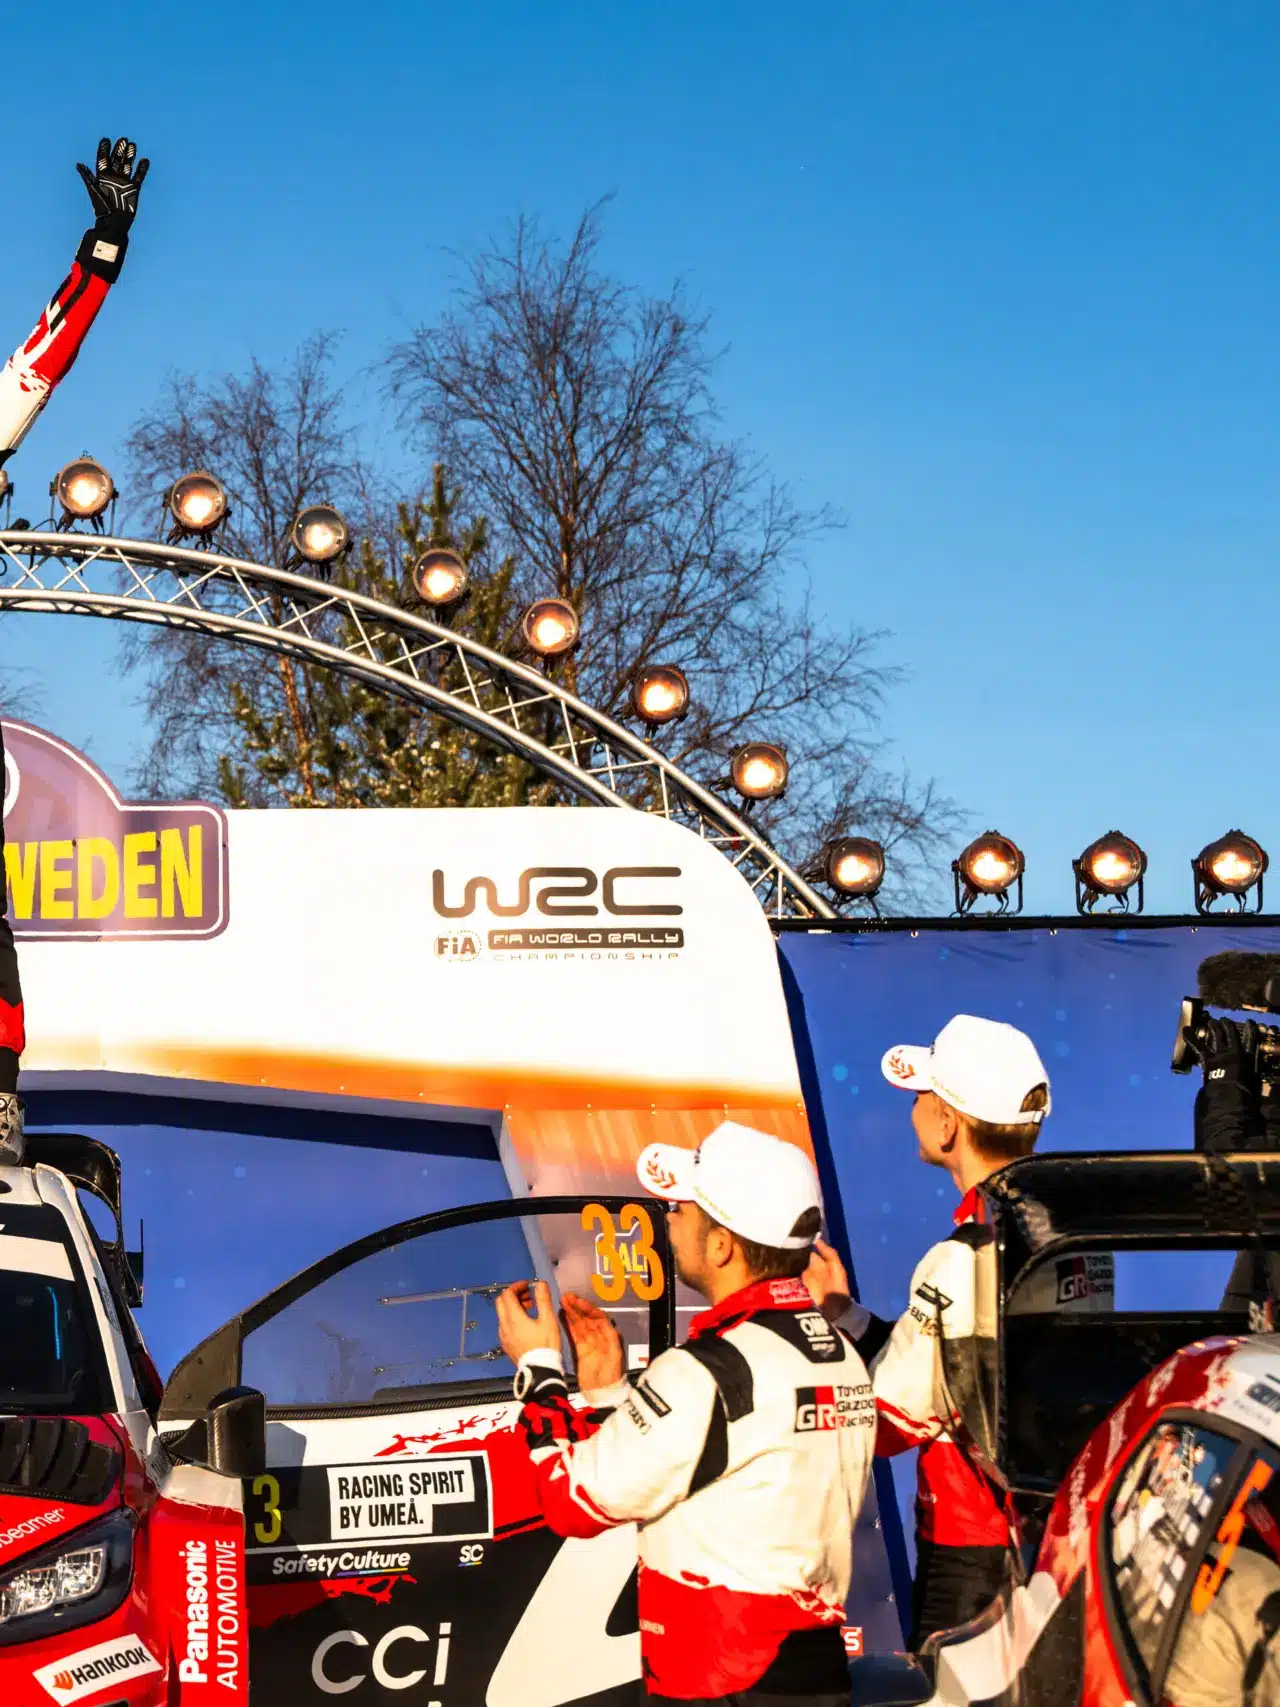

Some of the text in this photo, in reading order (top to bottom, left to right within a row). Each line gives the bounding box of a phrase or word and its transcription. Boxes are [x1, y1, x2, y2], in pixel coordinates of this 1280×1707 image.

[3, 825, 203, 920] WEDEN
[432, 867, 683, 918] WRC
[493, 933, 679, 944] FIA WORLD RALLY
[581, 1203, 665, 1302] 33
[797, 1403, 836, 1430] GR
[338, 1470, 464, 1500] RACING SPIRIT
[340, 1498, 424, 1529] BY UMEÅ.
[272, 1550, 410, 1577] SafetyCulture
[459, 1544, 484, 1562] SC
[179, 1540, 209, 1683] Panasonic
[215, 1539, 239, 1690] AUTOMOTIVE
